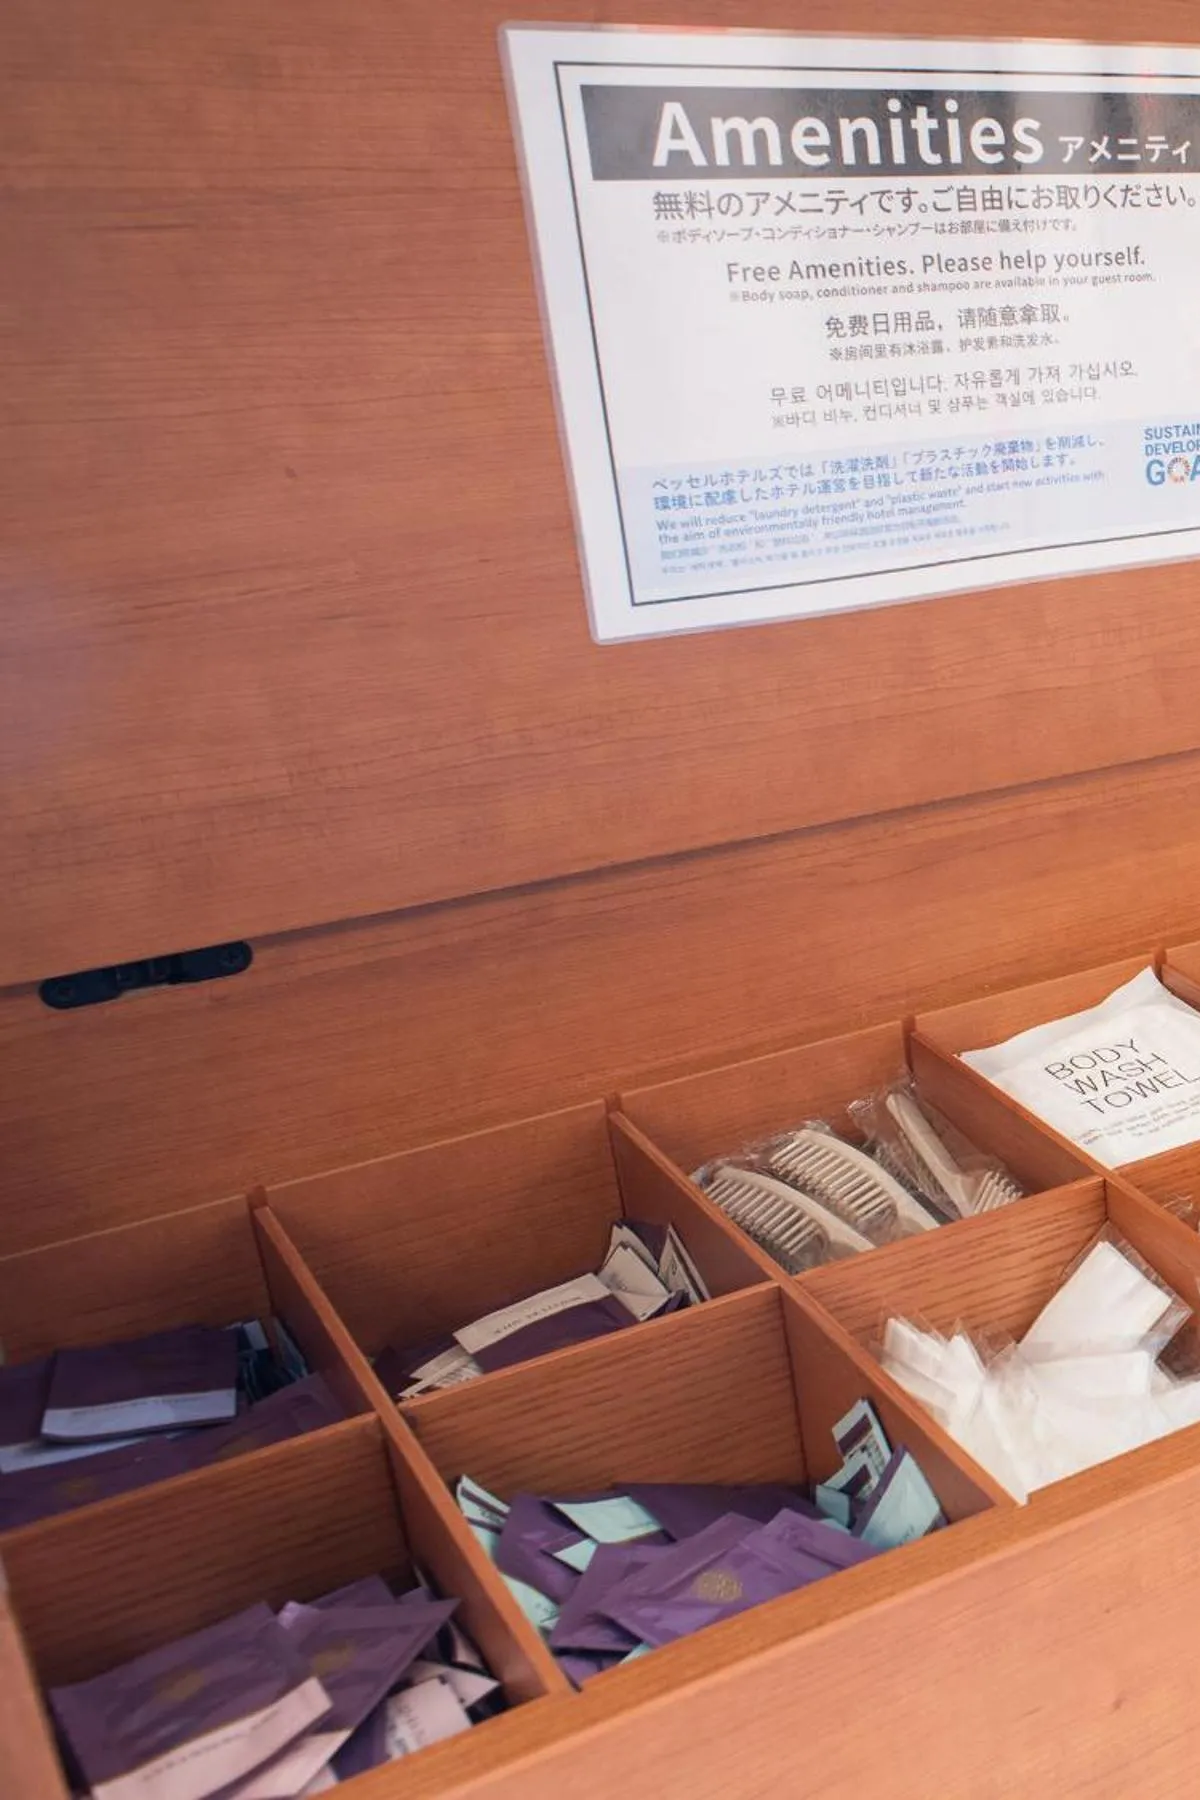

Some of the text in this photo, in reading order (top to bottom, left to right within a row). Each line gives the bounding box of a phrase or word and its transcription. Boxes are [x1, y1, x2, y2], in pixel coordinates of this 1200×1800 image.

[652, 98, 1045, 166] Amenities
[1058, 135, 1192, 164] アメニティ
[653, 185, 1196, 220] 無料のアメニティです。ご自由にお取りください。
[727, 246, 1145, 283] Free Amenities. Please help yourself.
[779, 290, 814, 302] soap,
[817, 284, 888, 298] conditioner
[892, 282, 914, 294] and
[917, 279, 970, 294] shampoo
[974, 280, 992, 290] are
[994, 275, 1045, 289] available
[1049, 275, 1060, 286] in
[1062, 275, 1088, 289] your
[1091, 273, 1121, 287] guest
[770, 386, 807, 407] 무료
[1028, 365, 1060, 384] 가져
[656, 519, 677, 532] We
[679, 516, 702, 529] will
[705, 512, 746, 526] reduce
[864, 495, 884, 508] and
[965, 482, 984, 495] and
[986, 479, 1011, 494] start
[1012, 479, 1033, 490] new
[1035, 473, 1081, 488] activities
[1083, 469, 1104, 483] with
[658, 532, 679, 545] the
[683, 529, 705, 542] aim
[708, 526, 721, 540] of
[724, 517, 818, 538] environmentally
[821, 511, 864, 529] friendly
[867, 507, 894, 521] hotel
[1044, 1038, 1143, 1080] BODY
[1064, 1052, 1168, 1096] WASH
